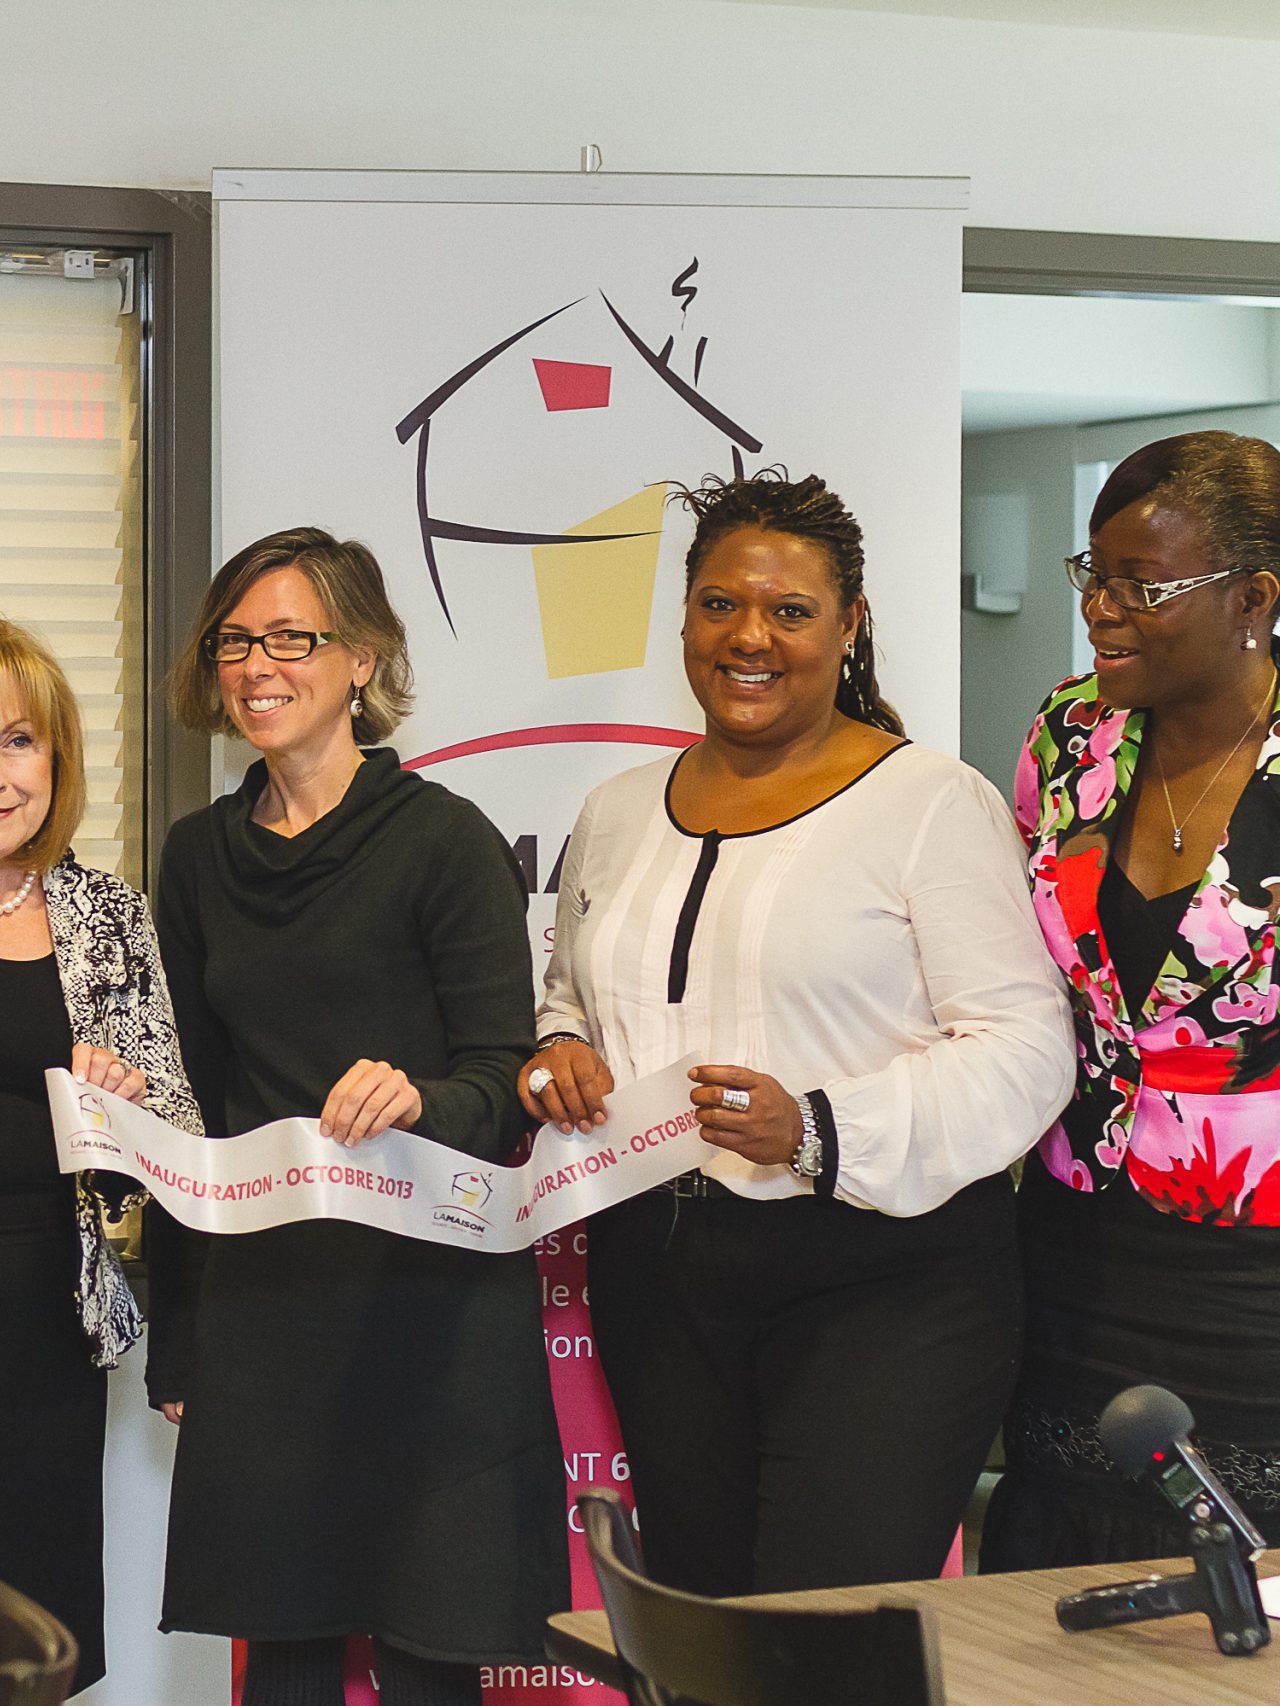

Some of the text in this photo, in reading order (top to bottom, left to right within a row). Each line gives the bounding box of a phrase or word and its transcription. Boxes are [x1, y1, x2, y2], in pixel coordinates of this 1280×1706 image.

[134, 1151, 273, 1201] INAUGURATION
[286, 1165, 374, 1191] OCTOBRE
[377, 1174, 414, 1200] 2013
[515, 1147, 618, 1223] INURATION
